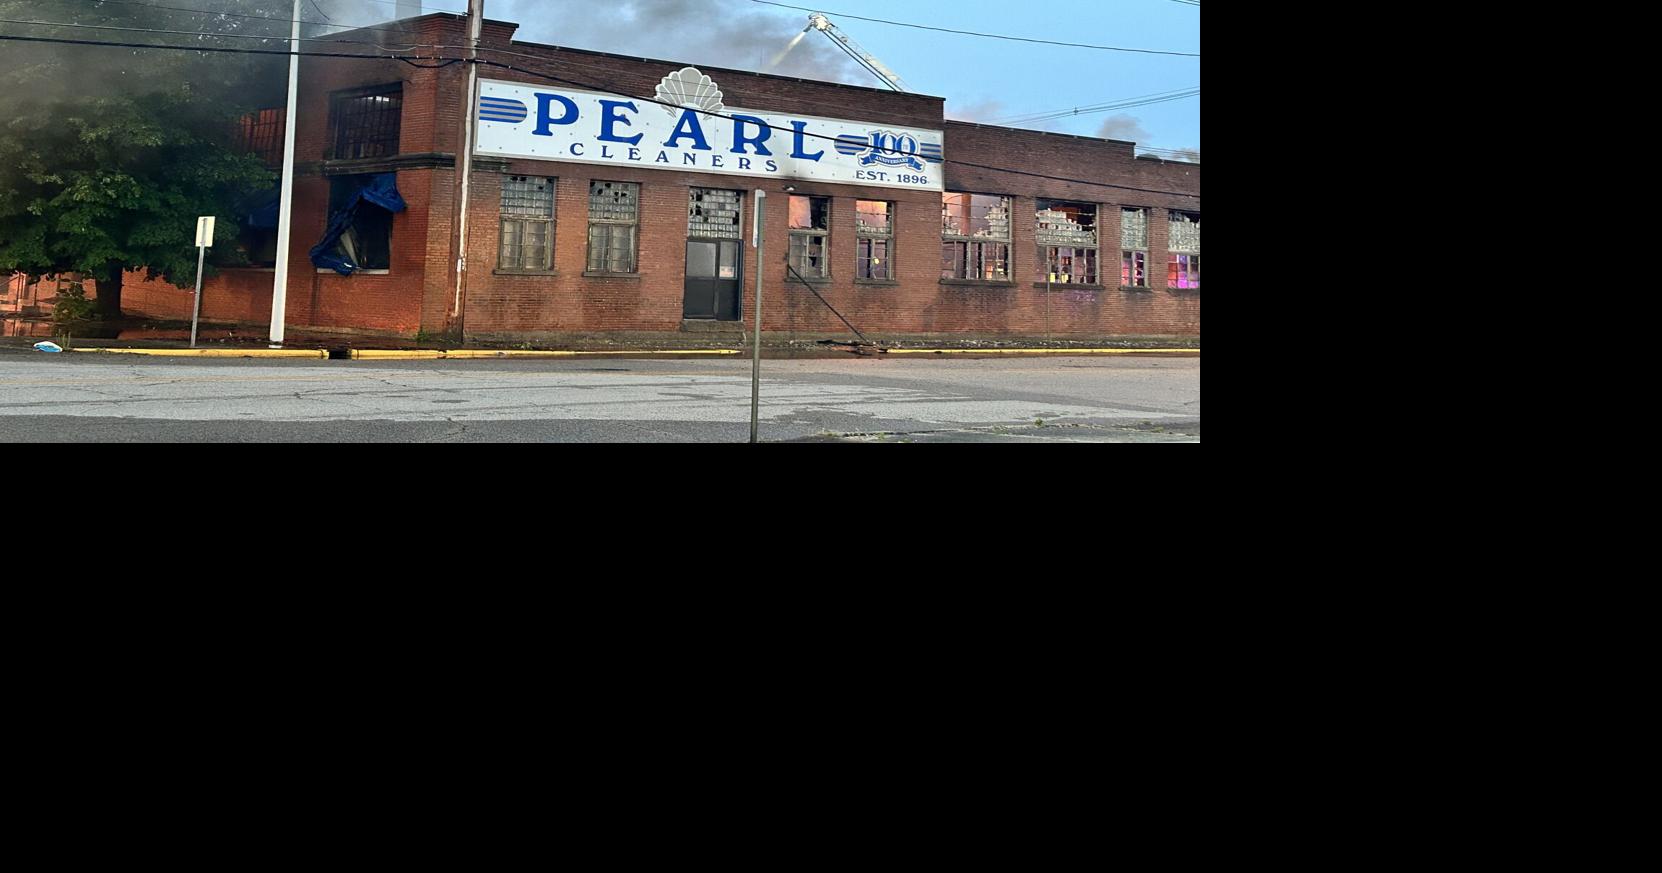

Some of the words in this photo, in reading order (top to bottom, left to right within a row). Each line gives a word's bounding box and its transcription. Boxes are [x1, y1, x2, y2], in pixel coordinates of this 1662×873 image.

[532, 92, 825, 162] PEARL
[569, 142, 778, 173] CLEANERS
[870, 132, 916, 157] 100
[856, 170, 890, 182] EST.
[897, 174, 928, 185] 1896
